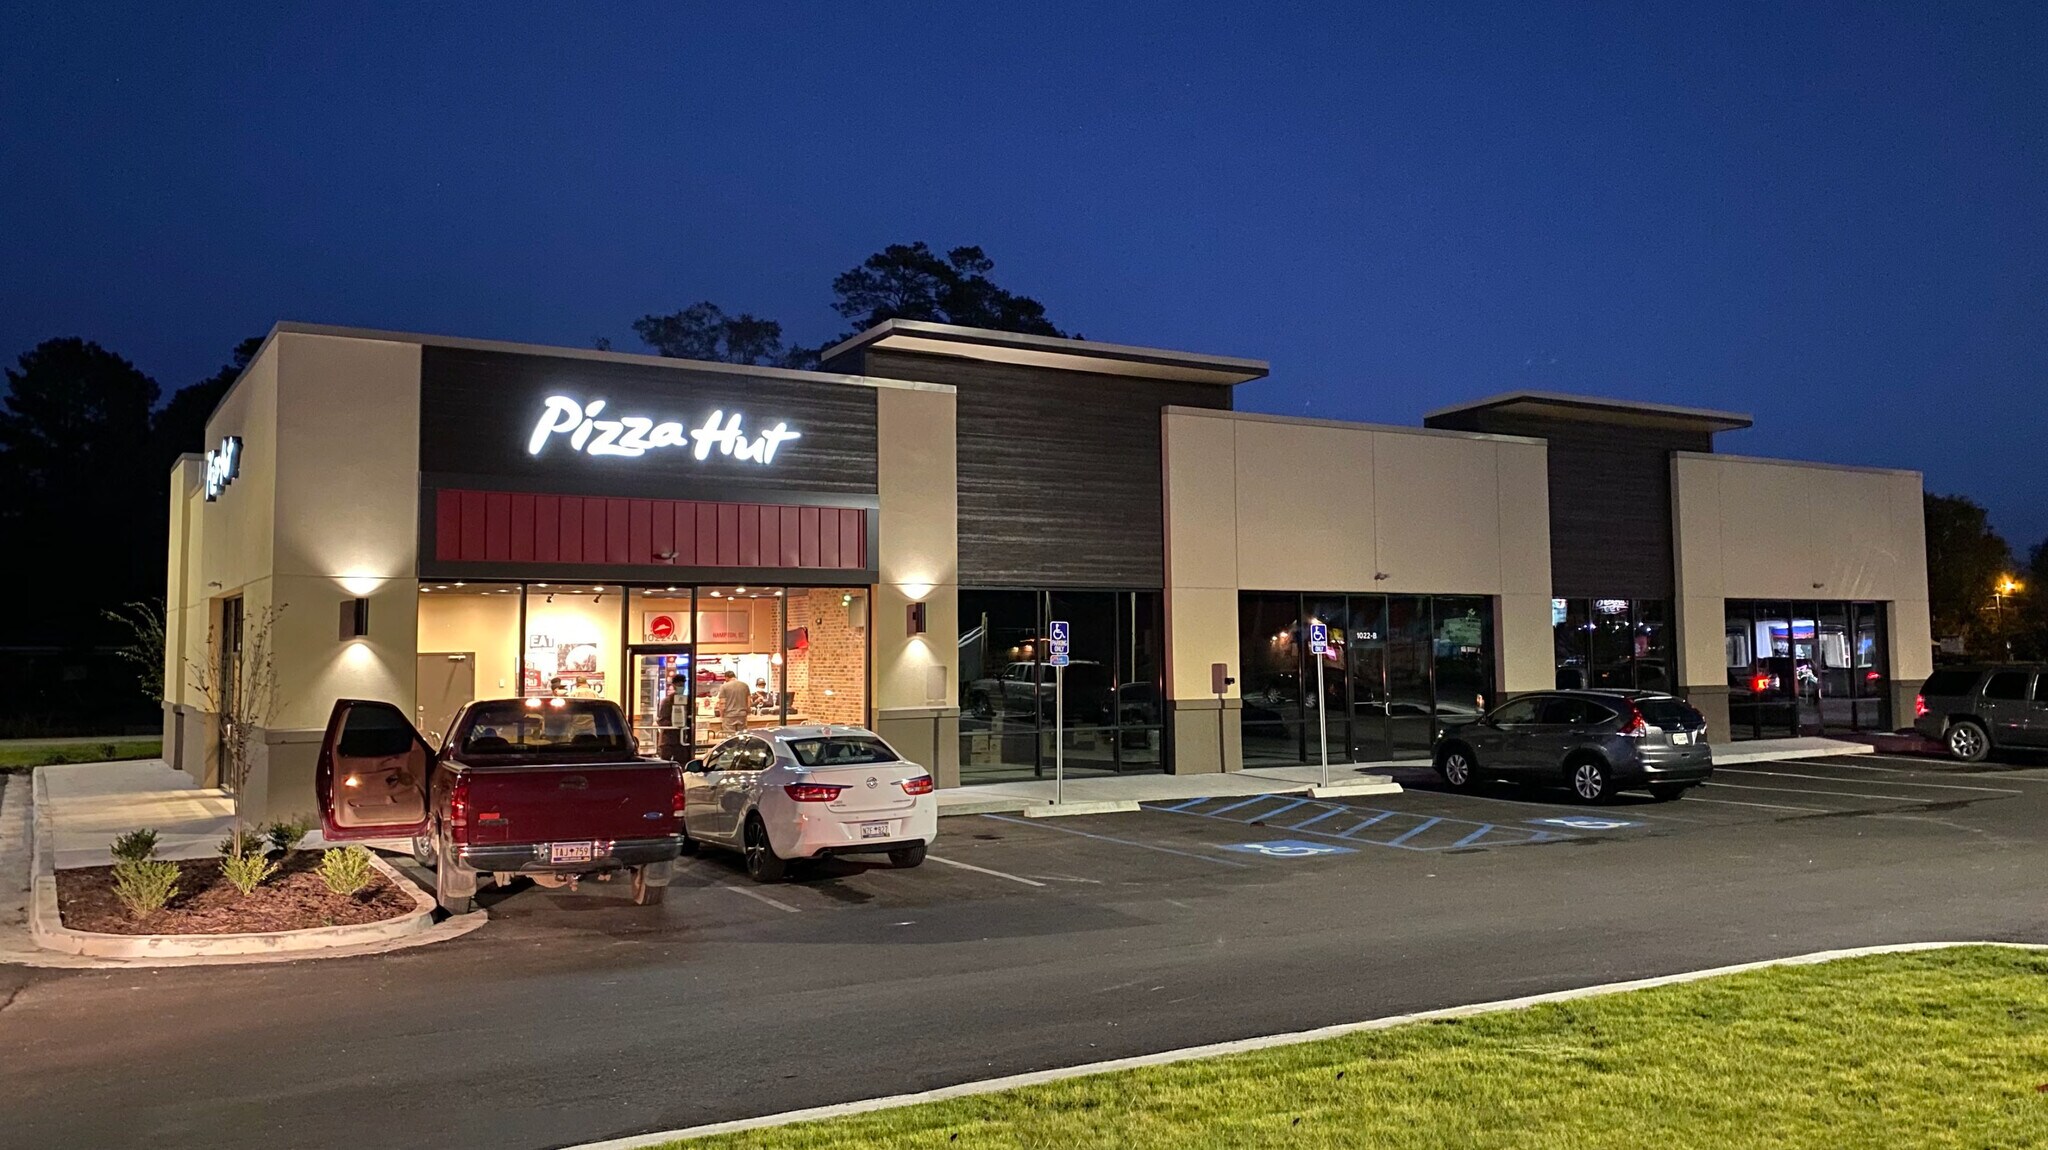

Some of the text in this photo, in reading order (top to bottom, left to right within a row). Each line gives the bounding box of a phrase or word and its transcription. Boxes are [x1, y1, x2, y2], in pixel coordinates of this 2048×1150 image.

[529, 395, 801, 464] Pizza Hut
[555, 847, 589, 856] TAJ 759
